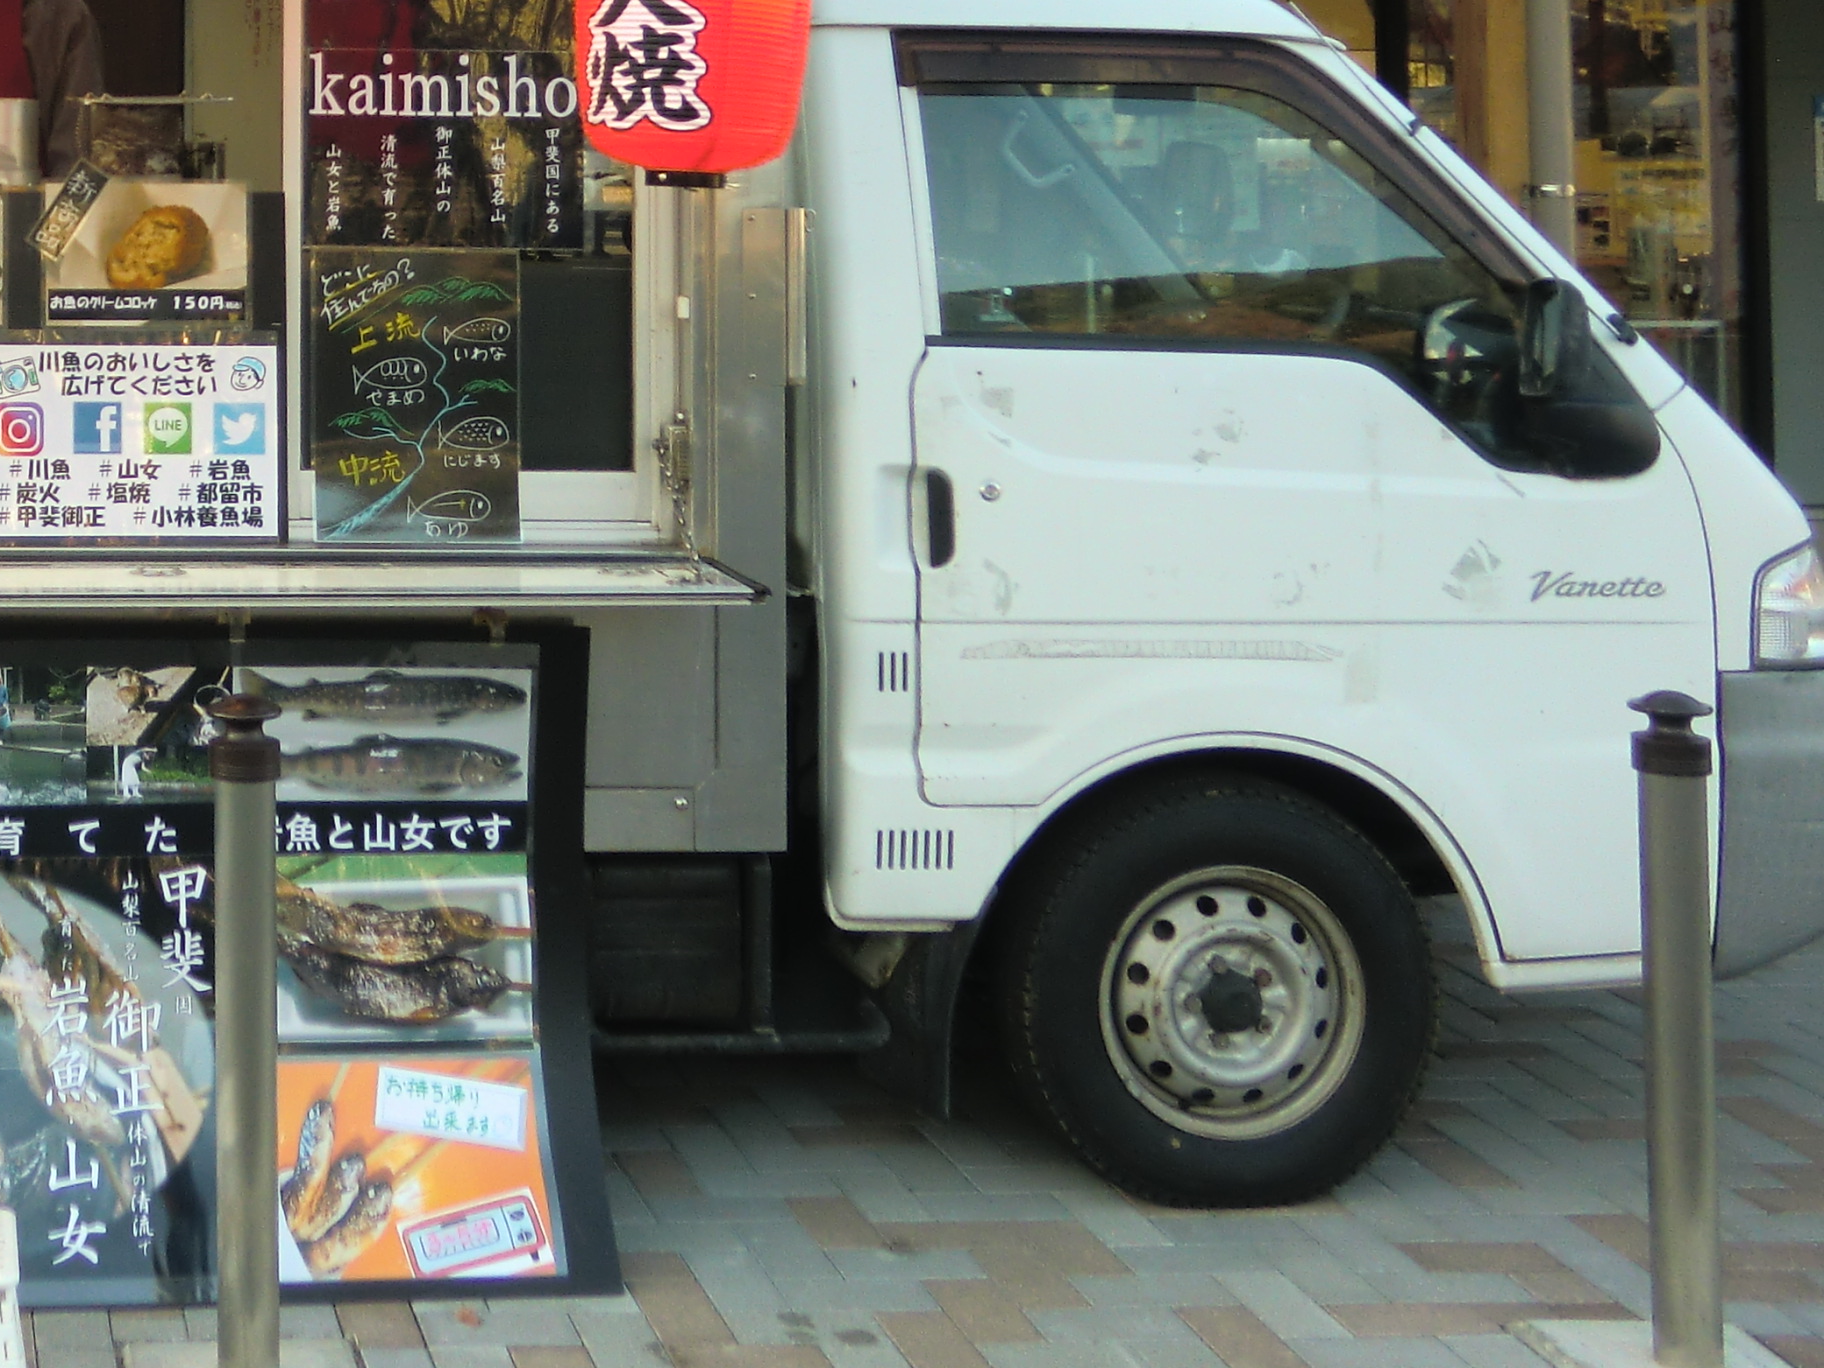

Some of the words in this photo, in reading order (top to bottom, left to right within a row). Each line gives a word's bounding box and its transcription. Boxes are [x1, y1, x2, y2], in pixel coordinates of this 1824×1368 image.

[308, 52, 578, 119] kaimisho
[434, 125, 454, 213] 御正体山の
[489, 137, 507, 224] 山梨百名山
[544, 128, 562, 234] 甲斐国にある
[325, 143, 343, 232] 山女と岩魚
[379, 134, 399, 240] 清流で育った
[36, 170, 96, 249] 新商品
[49, 294, 159, 311] お魚のクリームコロッケ
[350, 311, 422, 354] 上流
[38, 351, 216, 374] 川魚のおいしさを
[453, 343, 508, 363] いわな
[61, 374, 218, 396] 広げてください
[365, 386, 426, 406] やまめ
[154, 419, 182, 432] LINE
[337, 449, 407, 488] 中流
[442, 452, 501, 469] にじます
[424, 520, 470, 539] あゆ
[1528, 569, 1668, 603] Vanette
[274, 813, 513, 853] 魚と山女です
[385, 1075, 480, 1109] お持ち帰り
[422, 1109, 491, 1138] 出来ます
